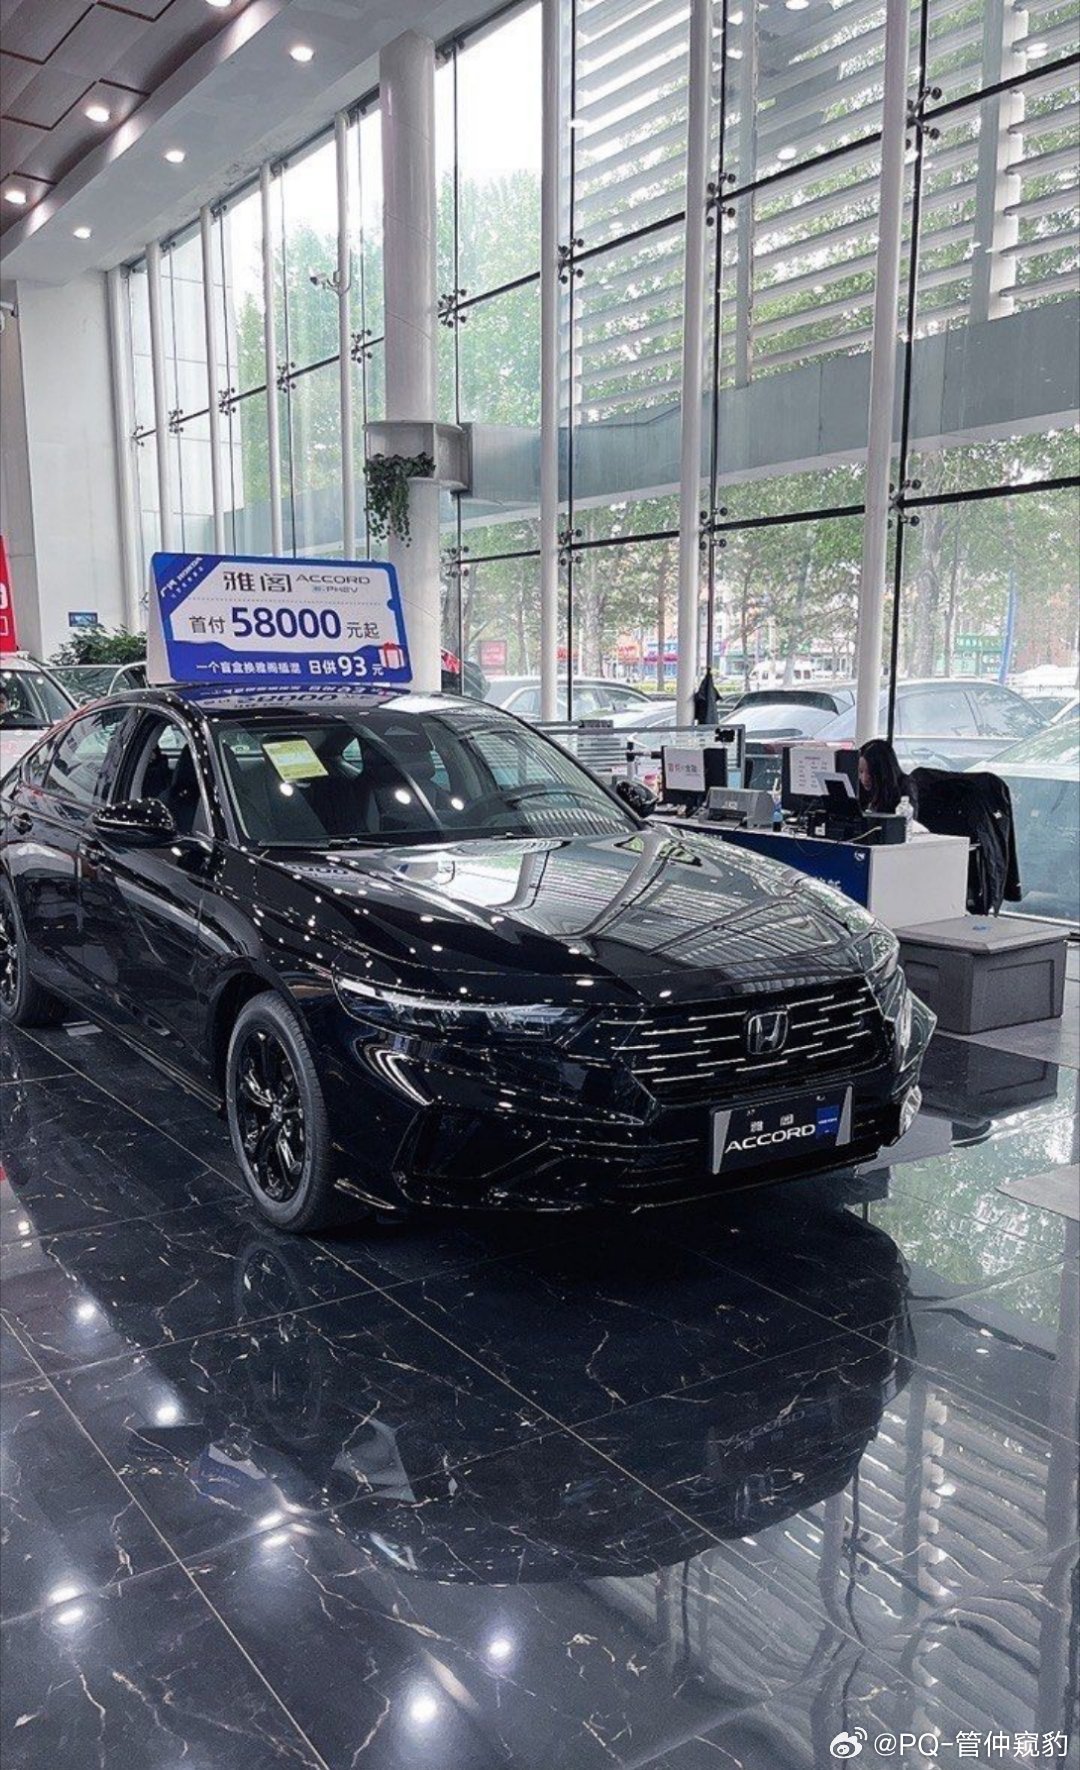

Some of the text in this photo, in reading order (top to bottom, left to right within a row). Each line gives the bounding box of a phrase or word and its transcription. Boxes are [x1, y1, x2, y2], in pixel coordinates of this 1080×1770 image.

[223, 571, 293, 593] 雅阁
[296, 574, 371, 584] ACCORD
[189, 607, 380, 639] 首付 58000 元起
[725, 1124, 816, 1154] ACCORD
